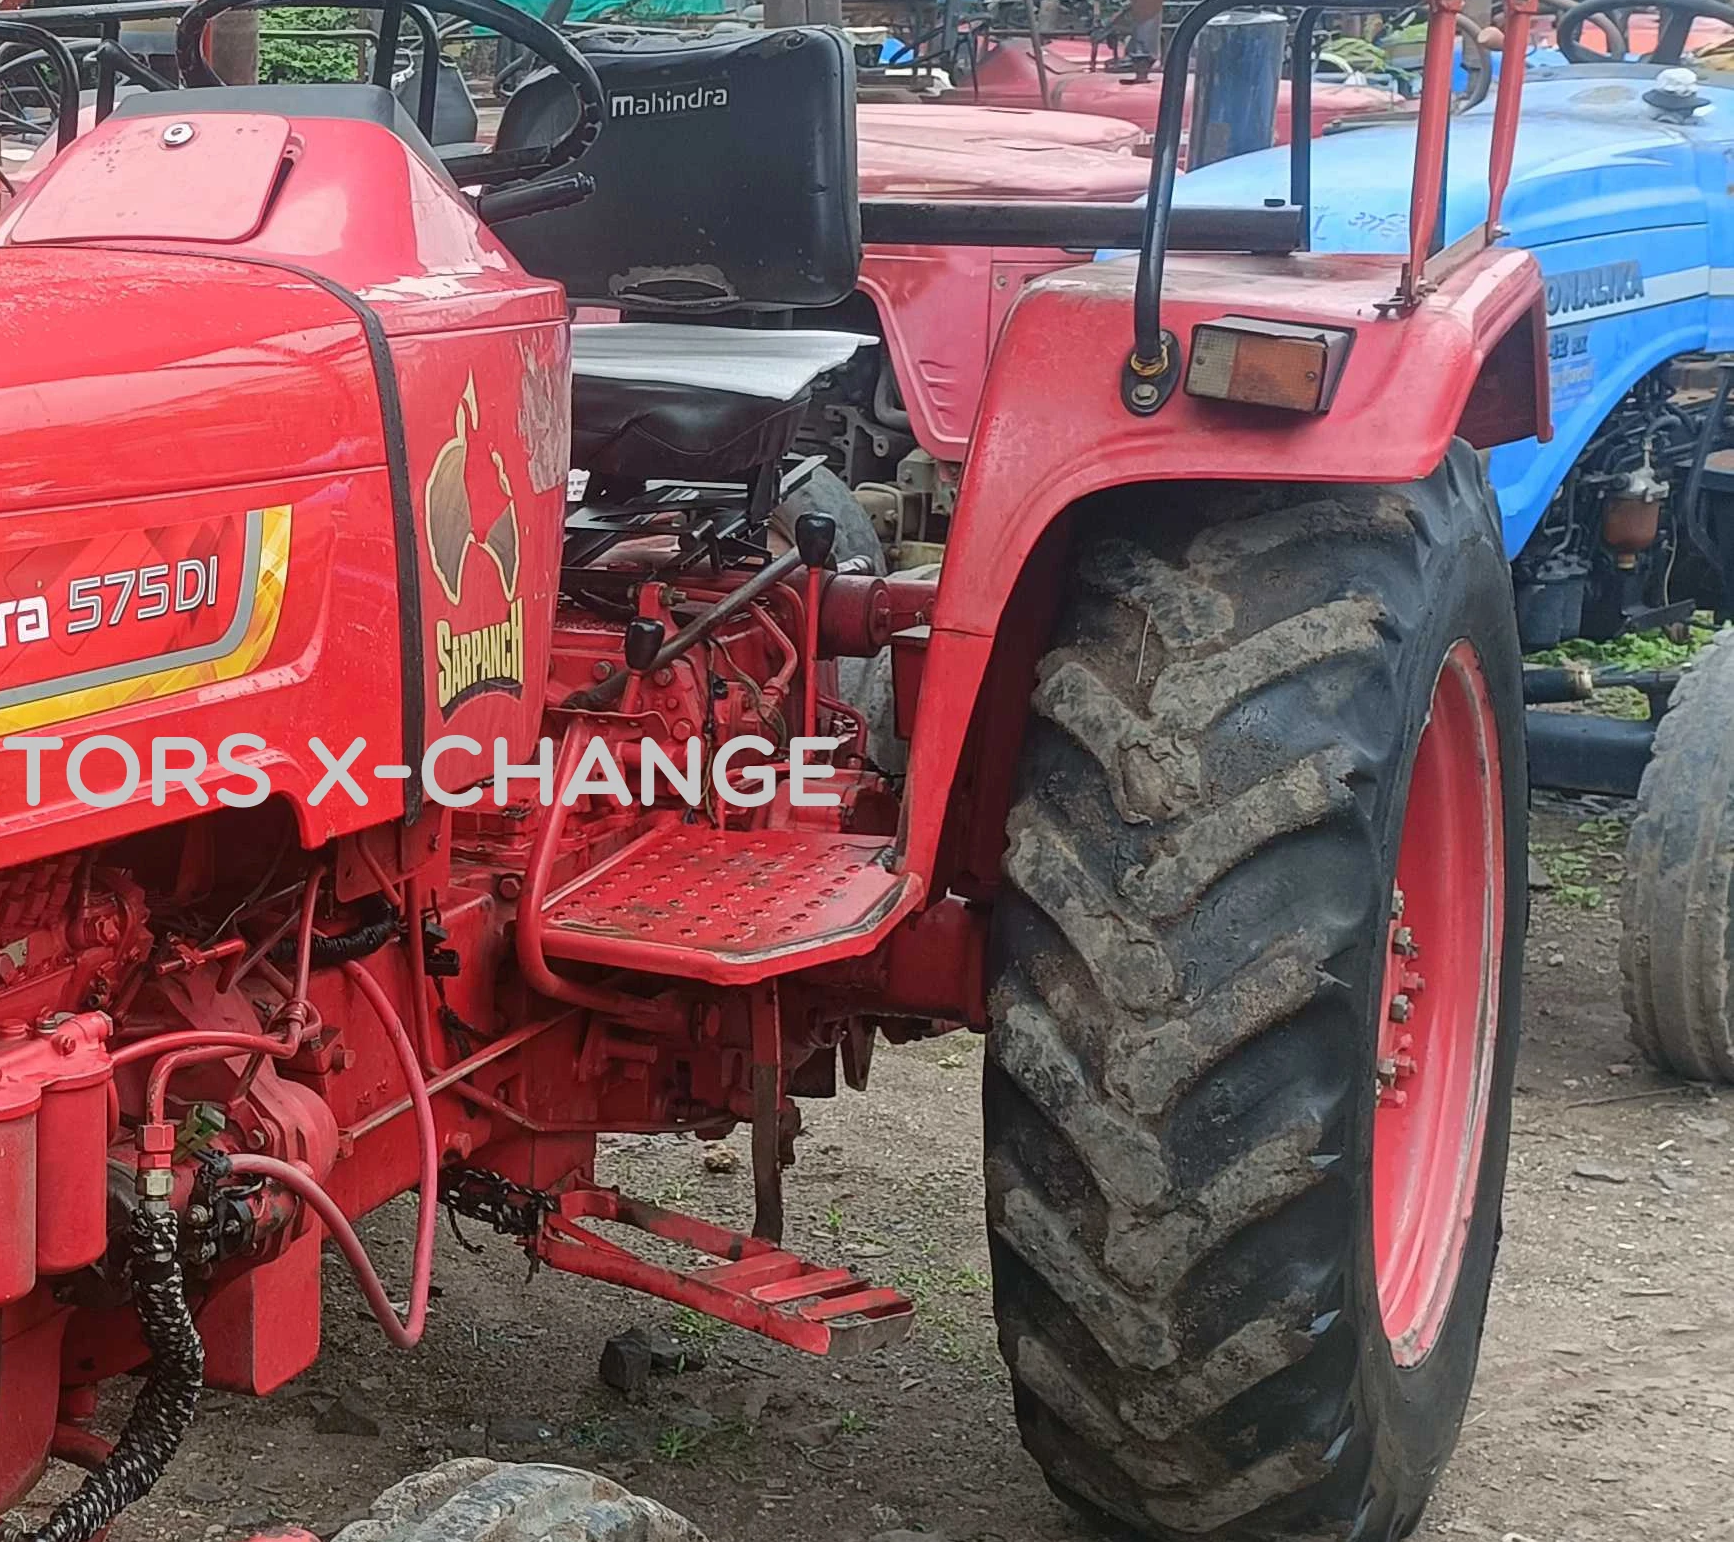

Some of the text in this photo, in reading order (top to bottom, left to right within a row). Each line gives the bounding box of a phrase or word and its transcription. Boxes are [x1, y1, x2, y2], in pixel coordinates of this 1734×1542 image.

[611, 86, 727, 117] Mahindra
[1547, 260, 1644, 316] ONALIKA
[436, 597, 523, 708] SARPANCH
